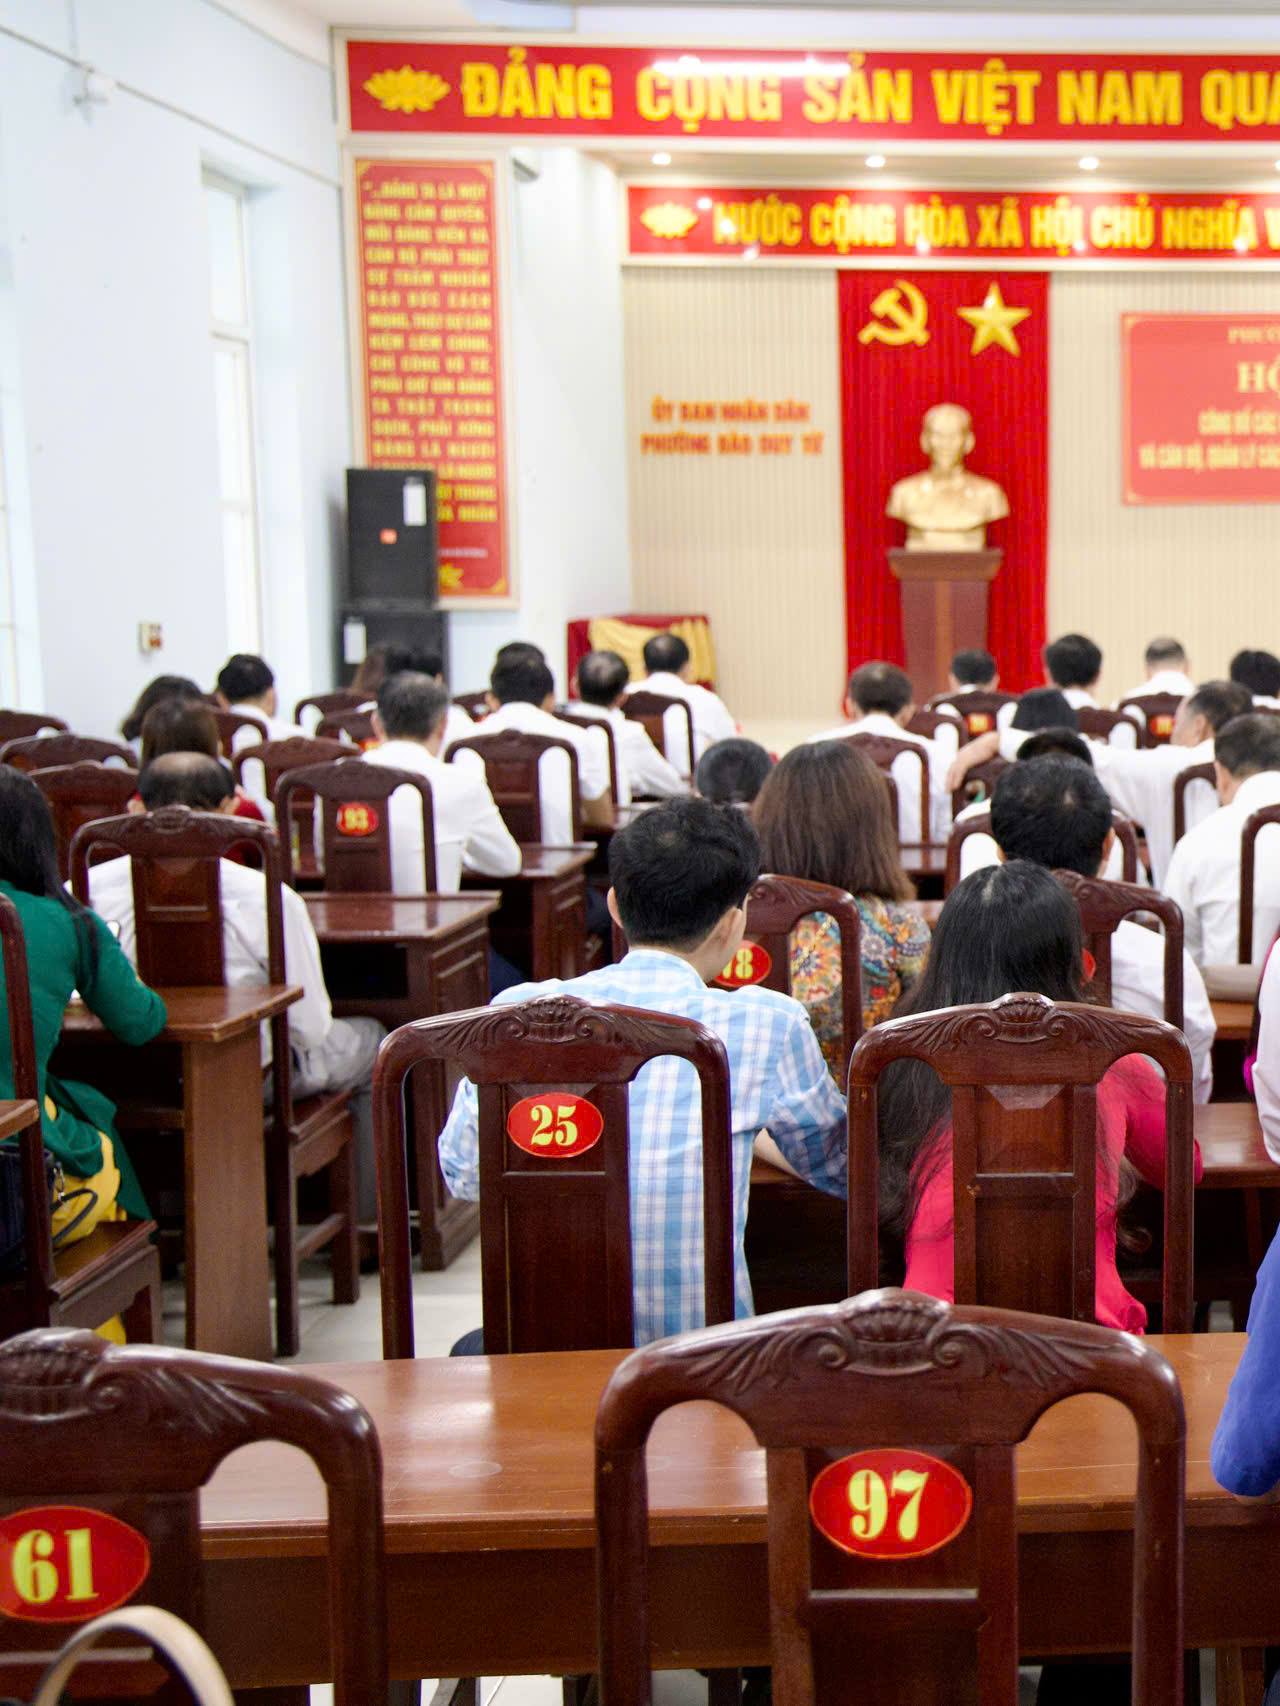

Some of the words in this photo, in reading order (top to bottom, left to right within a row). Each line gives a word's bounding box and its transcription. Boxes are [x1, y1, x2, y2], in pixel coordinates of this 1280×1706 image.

[461, 47, 613, 119] ĐẢNG
[636, 56, 783, 133] CỘNG
[802, 51, 913, 123] SẢN
[932, 58, 1041, 135] VIỆT
[1056, 70, 1183, 125] NAM
[712, 193, 803, 245] NƯỚC
[809, 194, 897, 255] CỘNG
[903, 194, 970, 249] HÒA
[974, 196, 1024, 248] XÃ
[1029, 195, 1085, 257] HỘI
[1090, 192, 1155, 249] CHỦ
[1160, 199, 1259, 250] NGHĨA
[531, 1104, 578, 1146] 25
[849, 1469, 929, 1541] 97
[12, 1528, 99, 1604] 61
